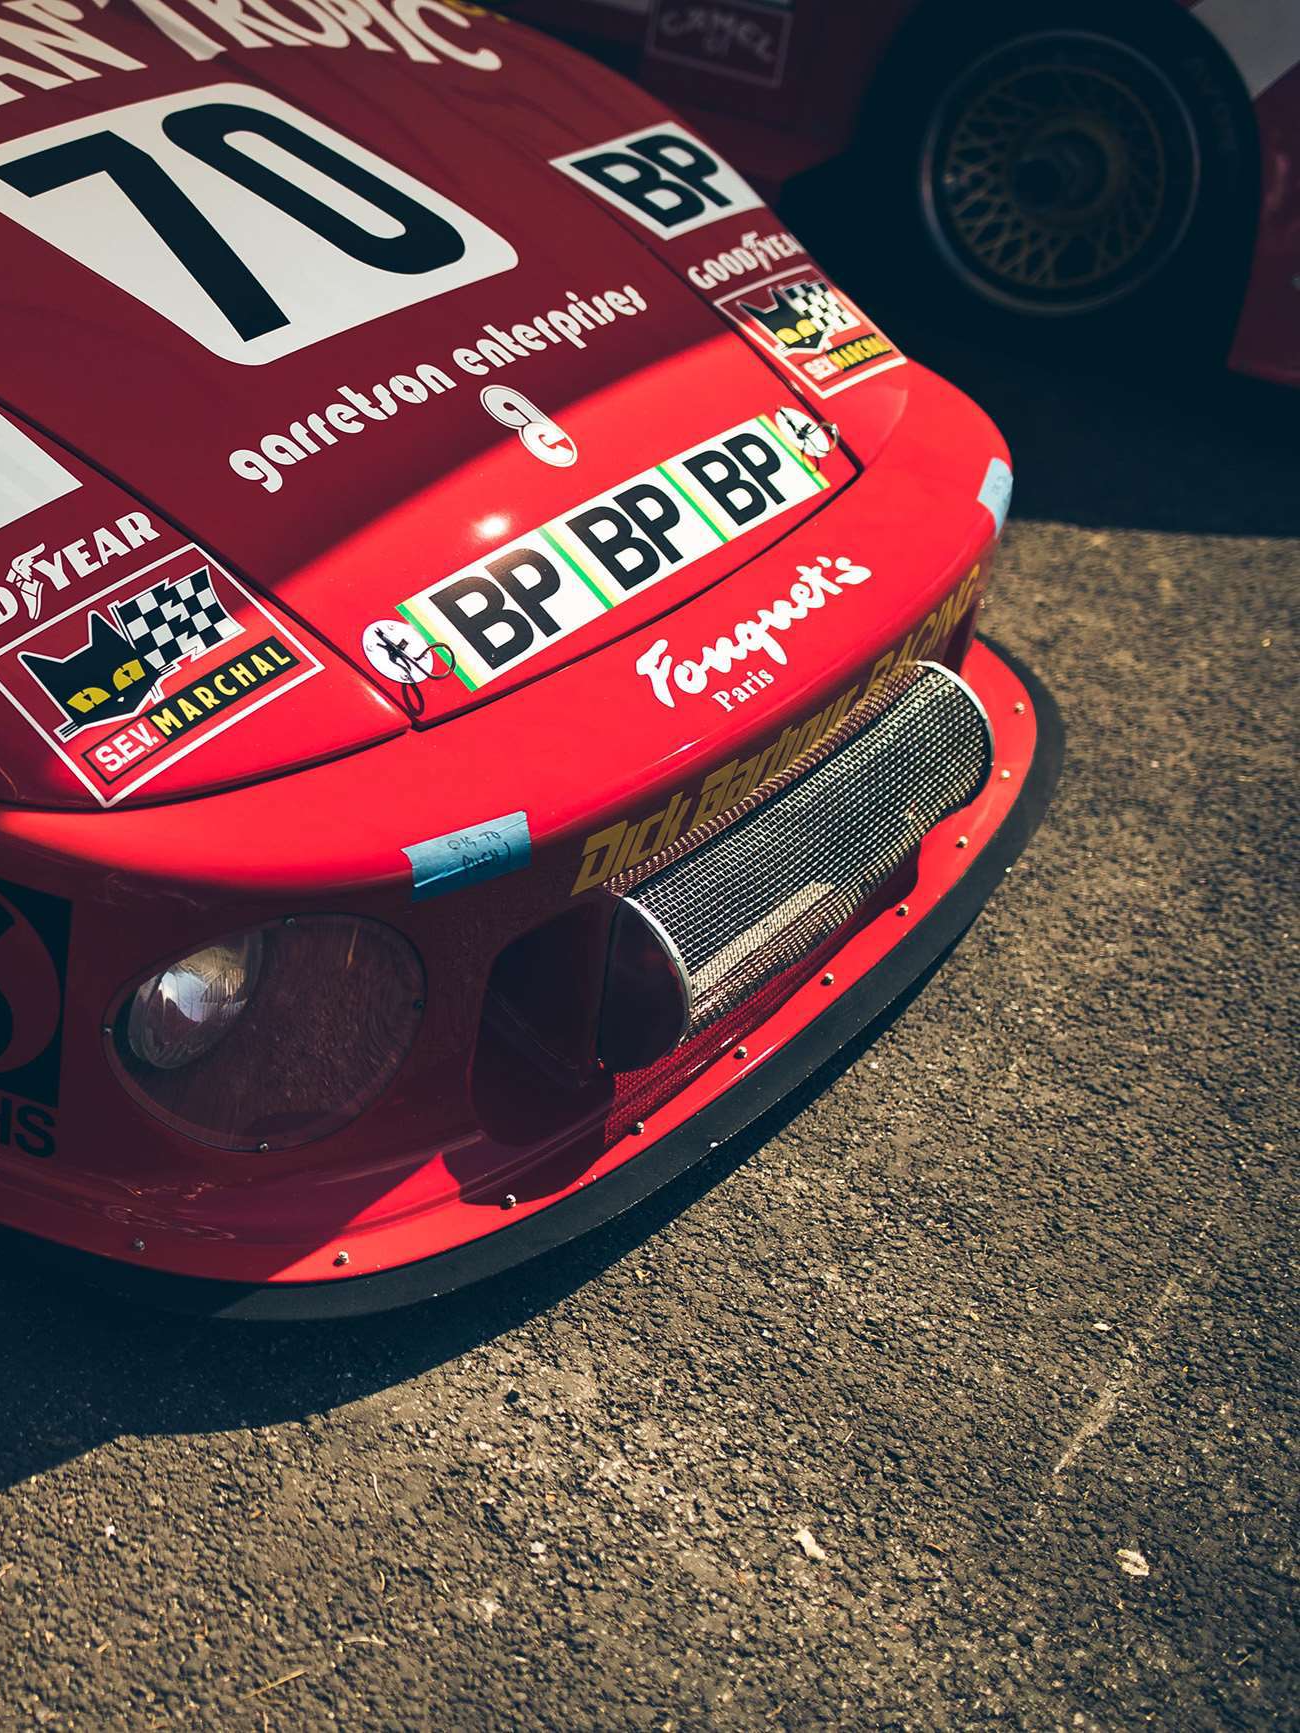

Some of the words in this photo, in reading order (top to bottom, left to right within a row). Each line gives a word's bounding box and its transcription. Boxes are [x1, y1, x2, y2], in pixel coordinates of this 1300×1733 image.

[98, 0, 502, 71] TROPIC
[570, 133, 732, 228] BP
[687, 230, 806, 290] GOODYEA
[228, 363, 457, 493] garretson
[452, 284, 647, 376] enterprises
[428, 549, 561, 670] BP
[566, 484, 681, 591] BP
[682, 433, 786, 525] BP
[149, 646, 292, 736] MARCHAL
[711, 668, 775, 712] Paris
